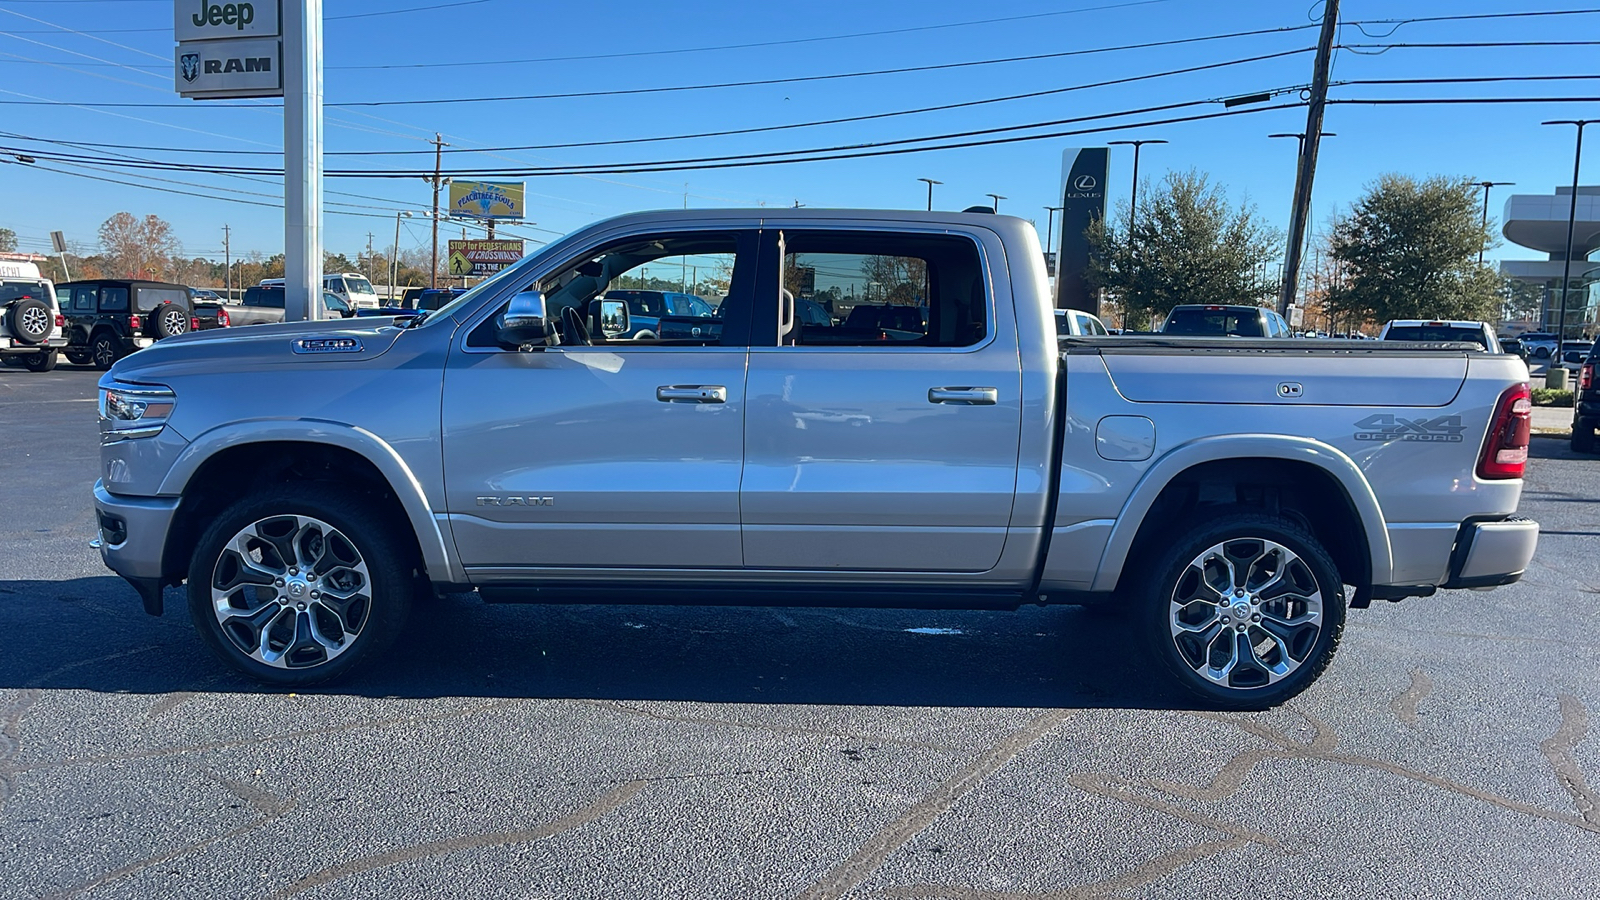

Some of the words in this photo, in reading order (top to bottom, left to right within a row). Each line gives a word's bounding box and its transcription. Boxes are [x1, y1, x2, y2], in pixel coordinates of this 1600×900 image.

[192, 0, 254, 30] Jeep
[204, 57, 271, 74] RAM
[450, 241, 467, 250] STOP
[467, 242, 478, 250] for
[478, 242, 522, 251] PEDESTRIANS
[466, 250, 477, 260] IN
[487, 263, 499, 271] THE
[1403, 434, 1462, 442] ROAD
[476, 495, 554, 507] RAM
